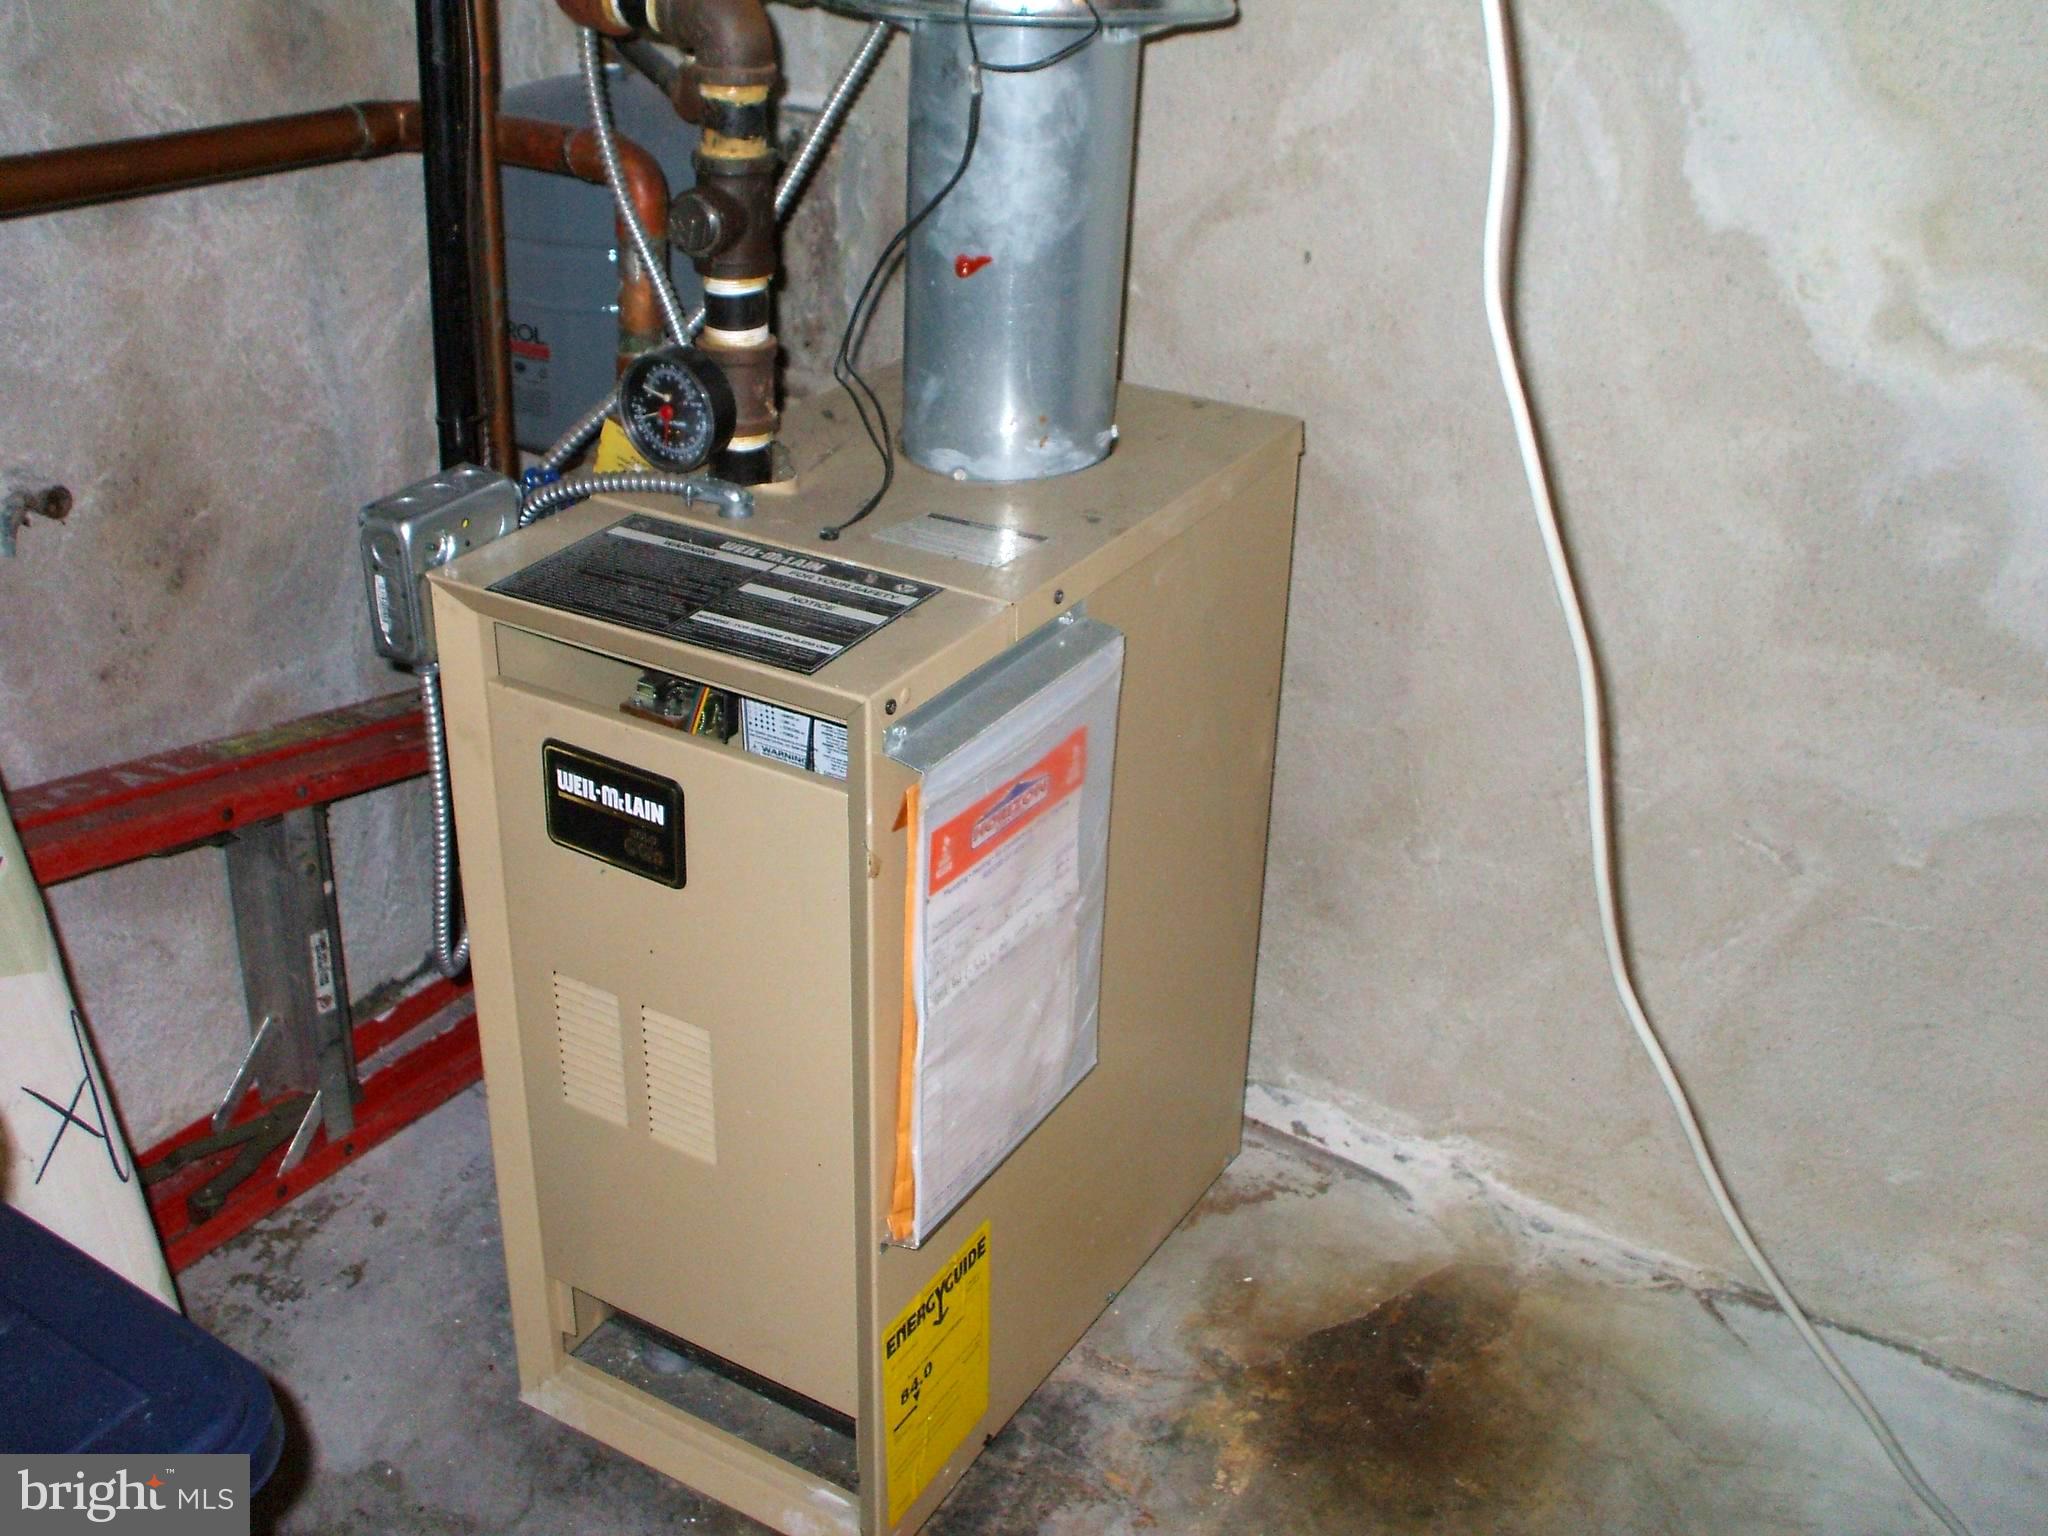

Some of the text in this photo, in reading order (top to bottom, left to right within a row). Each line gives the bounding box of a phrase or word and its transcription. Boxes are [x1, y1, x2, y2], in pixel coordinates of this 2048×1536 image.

[788, 569, 900, 600] FOR YOUR SAFETY
[789, 595, 834, 611] NOTICE
[887, 1236, 986, 1360] ENERGYGUIDE
[900, 1361, 933, 1406] 84.0
